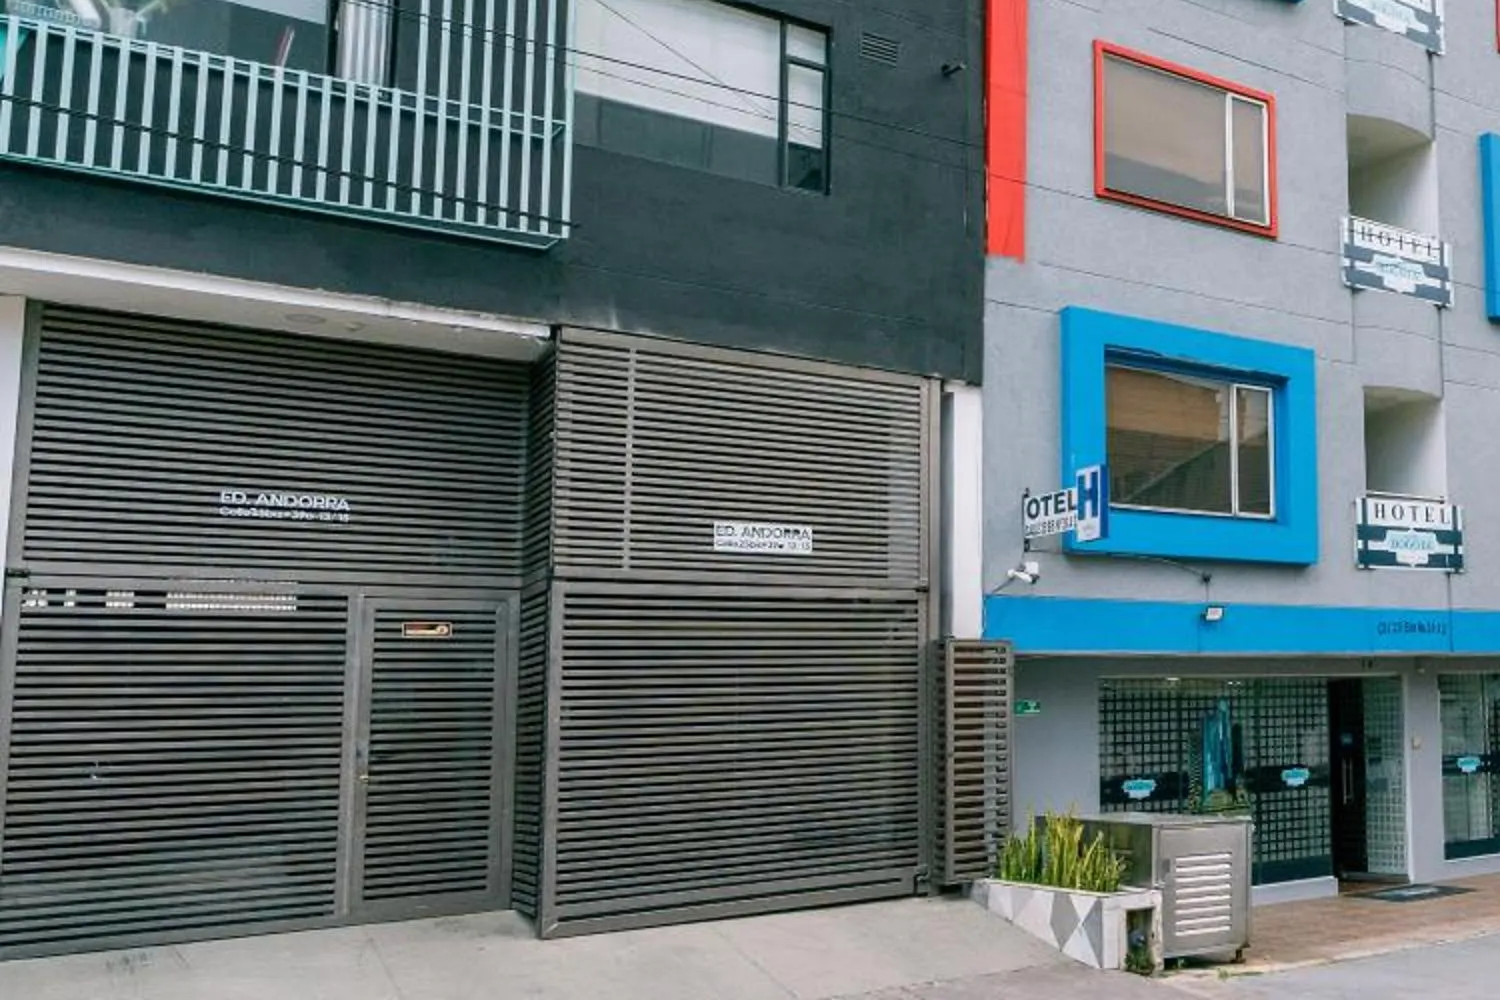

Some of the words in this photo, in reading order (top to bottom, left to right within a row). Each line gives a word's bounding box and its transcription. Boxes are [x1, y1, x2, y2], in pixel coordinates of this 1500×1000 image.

[220, 491, 250, 504] ED.
[255, 493, 350, 511] ANDORRA
[1374, 503, 1450, 524] HOTEL
[741, 526, 810, 540] ANDORRA
